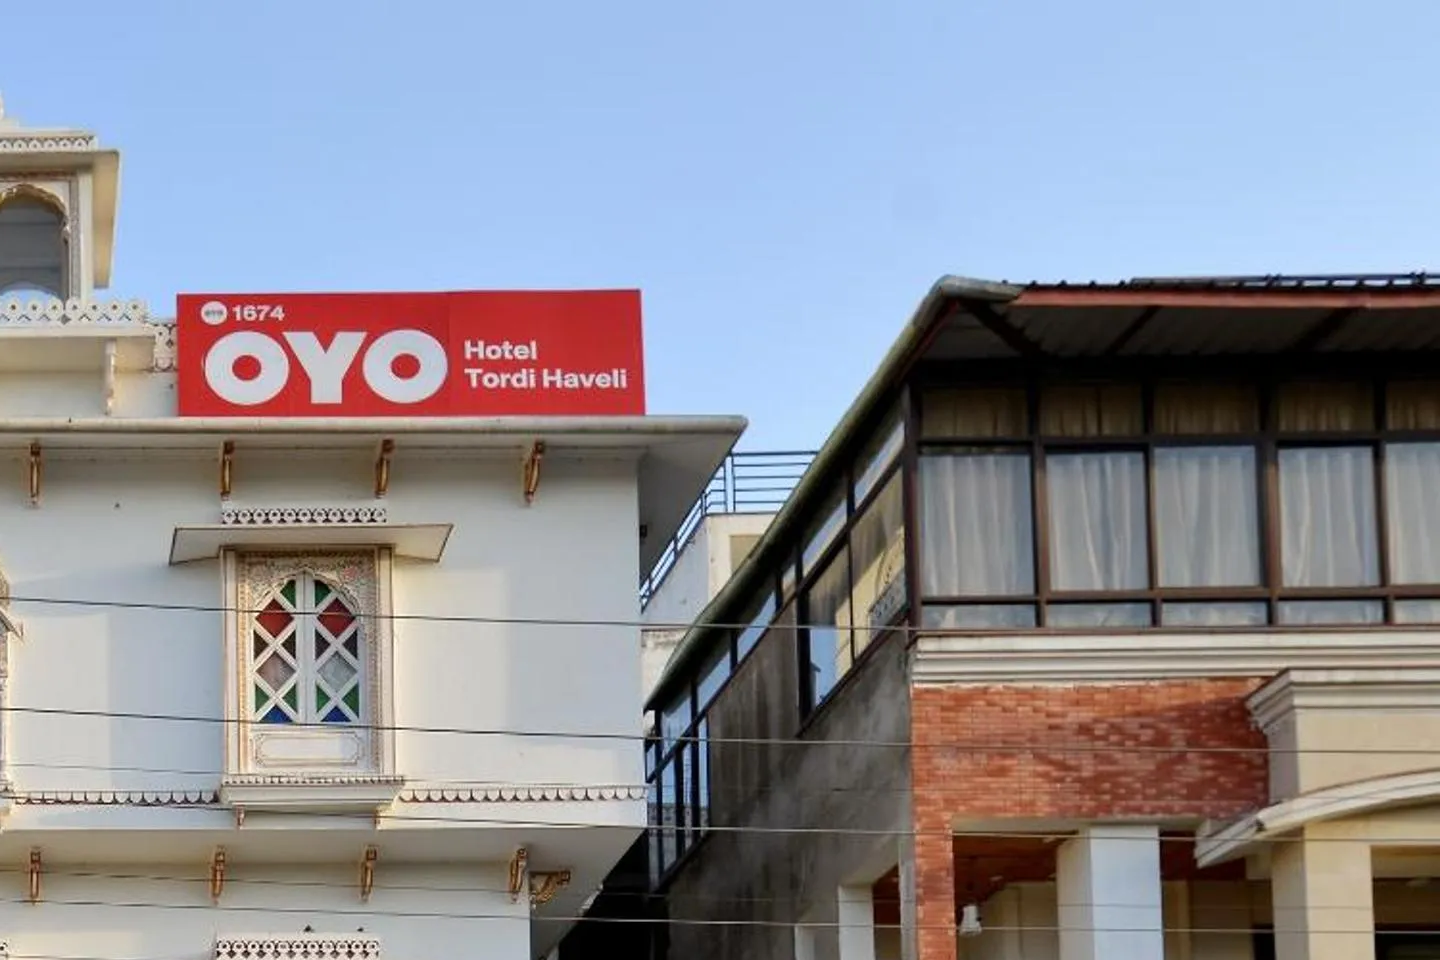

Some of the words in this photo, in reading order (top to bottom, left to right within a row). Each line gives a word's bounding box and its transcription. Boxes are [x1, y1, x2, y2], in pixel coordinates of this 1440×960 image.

[232, 304, 285, 322] 1674
[464, 339, 537, 360] Hotel
[203, 328, 448, 406] OYO
[464, 367, 536, 389] Tordi
[542, 367, 627, 389] Haveli
